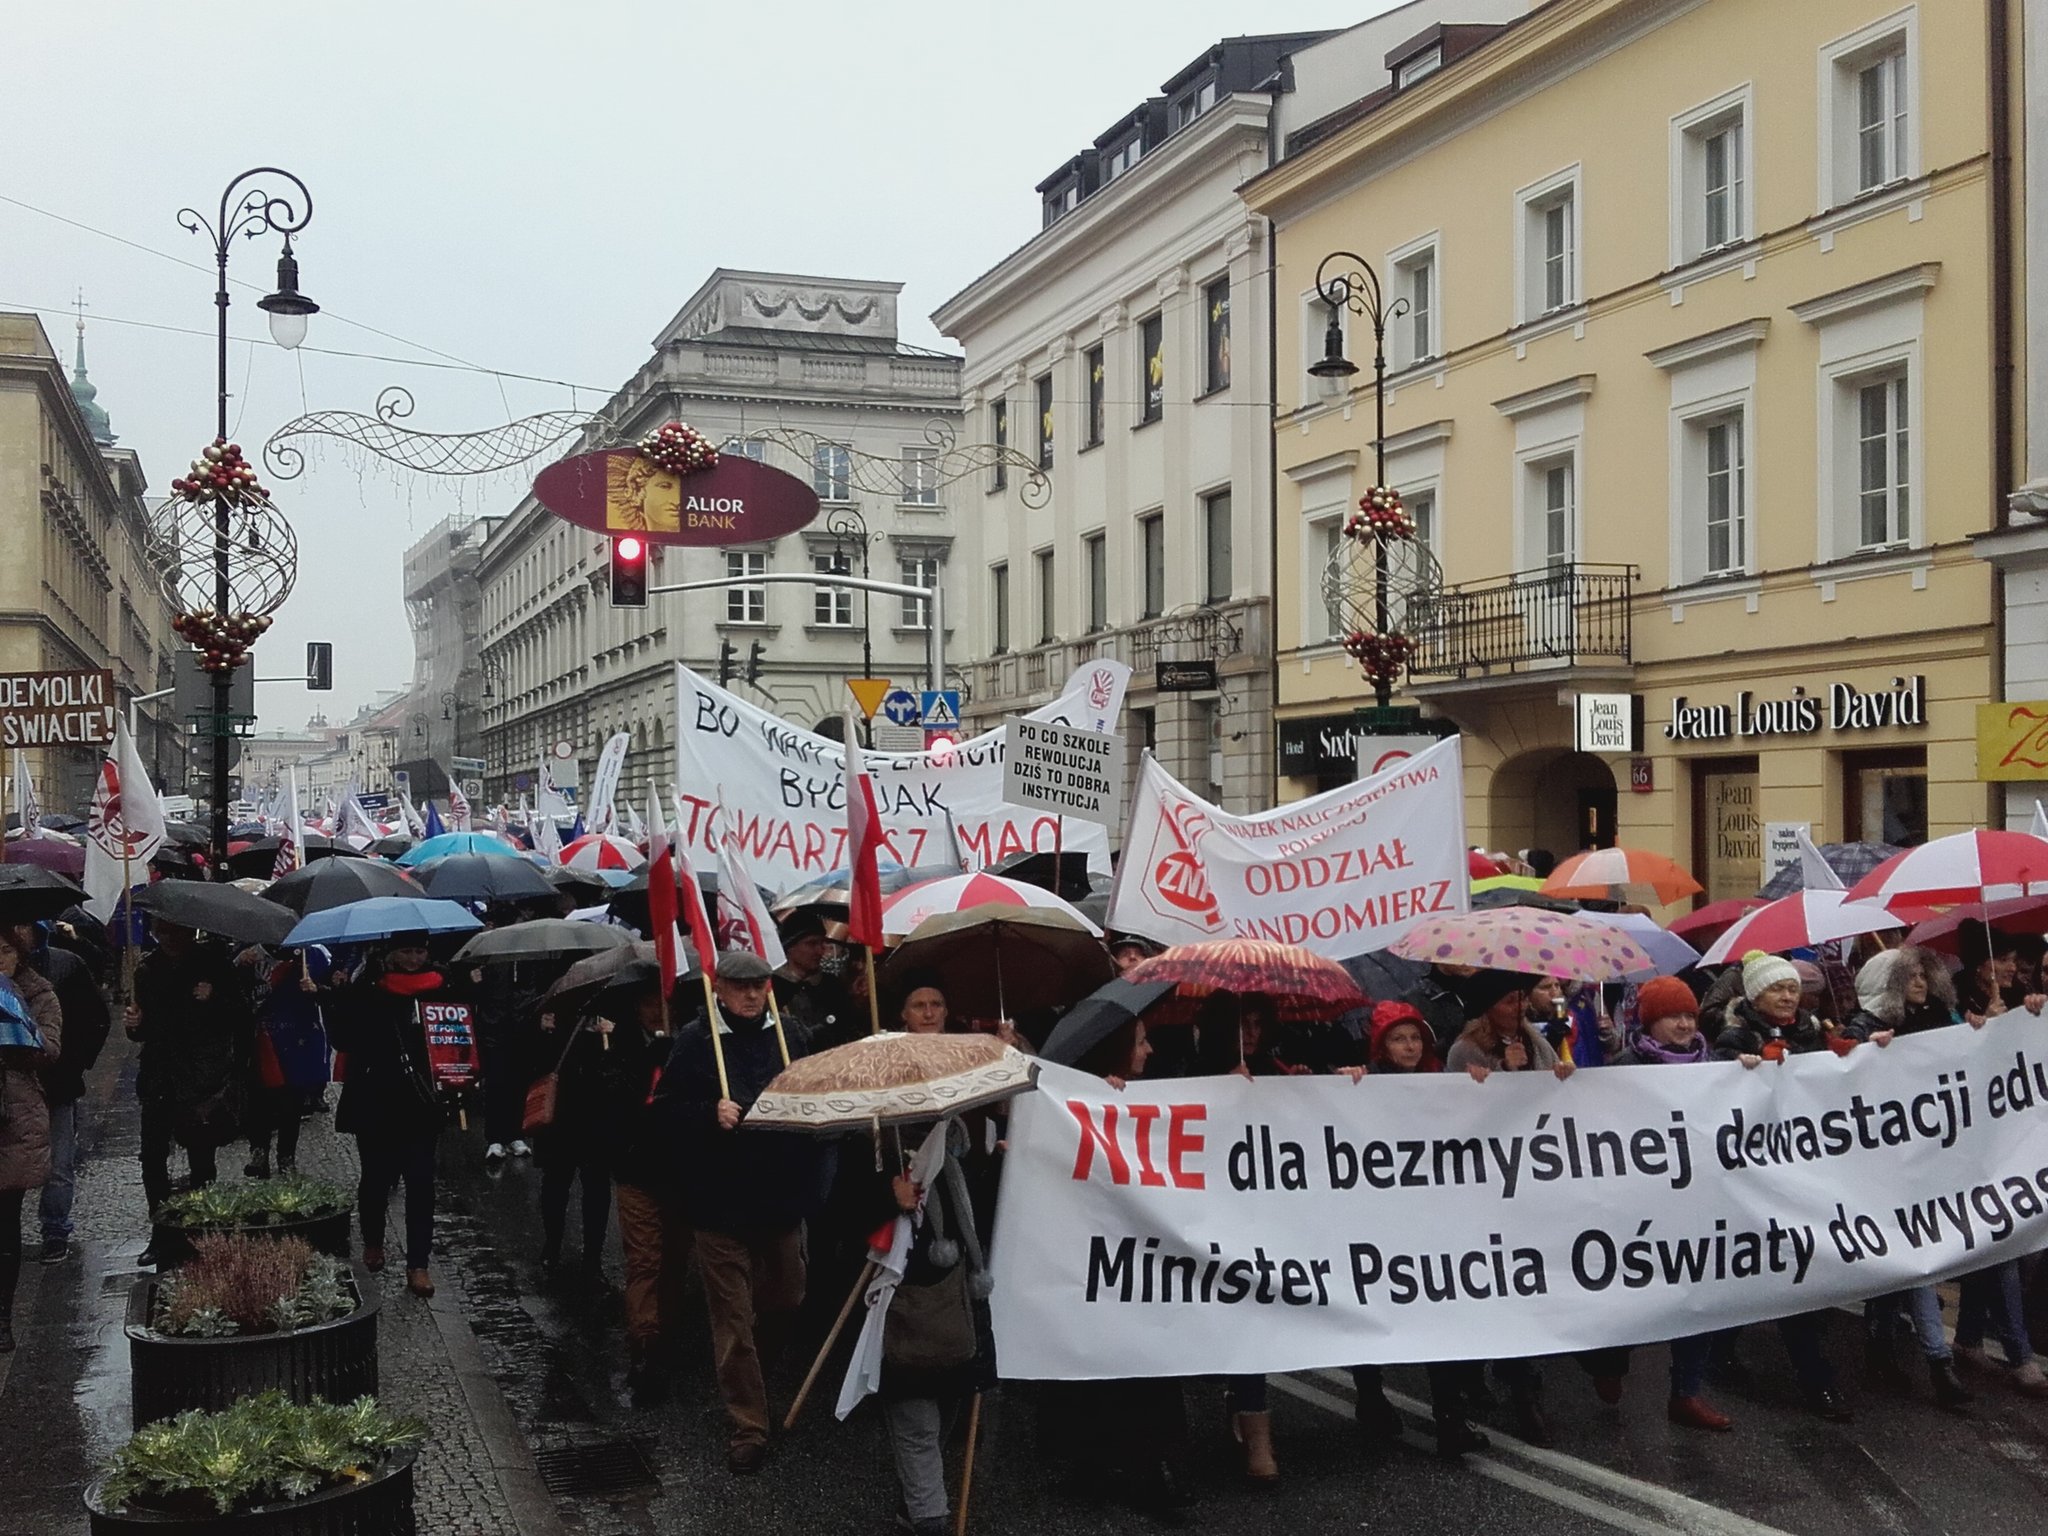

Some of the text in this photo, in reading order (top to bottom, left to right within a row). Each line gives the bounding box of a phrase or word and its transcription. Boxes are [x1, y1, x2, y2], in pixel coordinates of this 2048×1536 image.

[686, 496, 745, 515] ALIOR
[687, 513, 736, 531] BANK
[0, 674, 104, 708] DEMOLKI
[1589, 699, 1618, 716] Jean
[1589, 714, 1624, 732] Louis
[1663, 674, 1925, 741] Jean Louis David
[3, 706, 114, 745] ŚWIACIE!
[696, 690, 740, 738] BO
[760, 720, 826, 767] WAM
[1019, 724, 1111, 756] PO CO SZKOLE
[1590, 730, 1625, 747] David
[1999, 706, 2048, 769] Z
[1025, 745, 1103, 774] REWOLUCJA
[1285, 740, 1304, 756] Hotel
[1013, 761, 1112, 796] DZIŚ TO DOBRA
[1632, 766, 1649, 785] 66
[877, 782, 949, 817] JAK
[1022, 781, 1100, 812] INSTYTUCJA
[1716, 780, 1753, 806] Jean
[681, 794, 929, 874] TOWARZSZ
[1717, 806, 1760, 832] Louis
[1717, 833, 1760, 859] David
[1244, 837, 1414, 897] ODDZIAŁ
[1234, 880, 1456, 945] SANDOMIERZ
[425, 1005, 468, 1022] STOP
[1065, 1099, 1208, 1191] NIE
[1227, 1124, 1308, 1192] dla
[1324, 1110, 1693, 1199] bezmyślnej
[1716, 1069, 1973, 1172] dewastacji
[1085, 1235, 1332, 1307] Minister
[1348, 1232, 1548, 1307] Psucia
[1570, 1219, 1816, 1293] Oświaty
[1828, 1202, 1889, 1265] do
